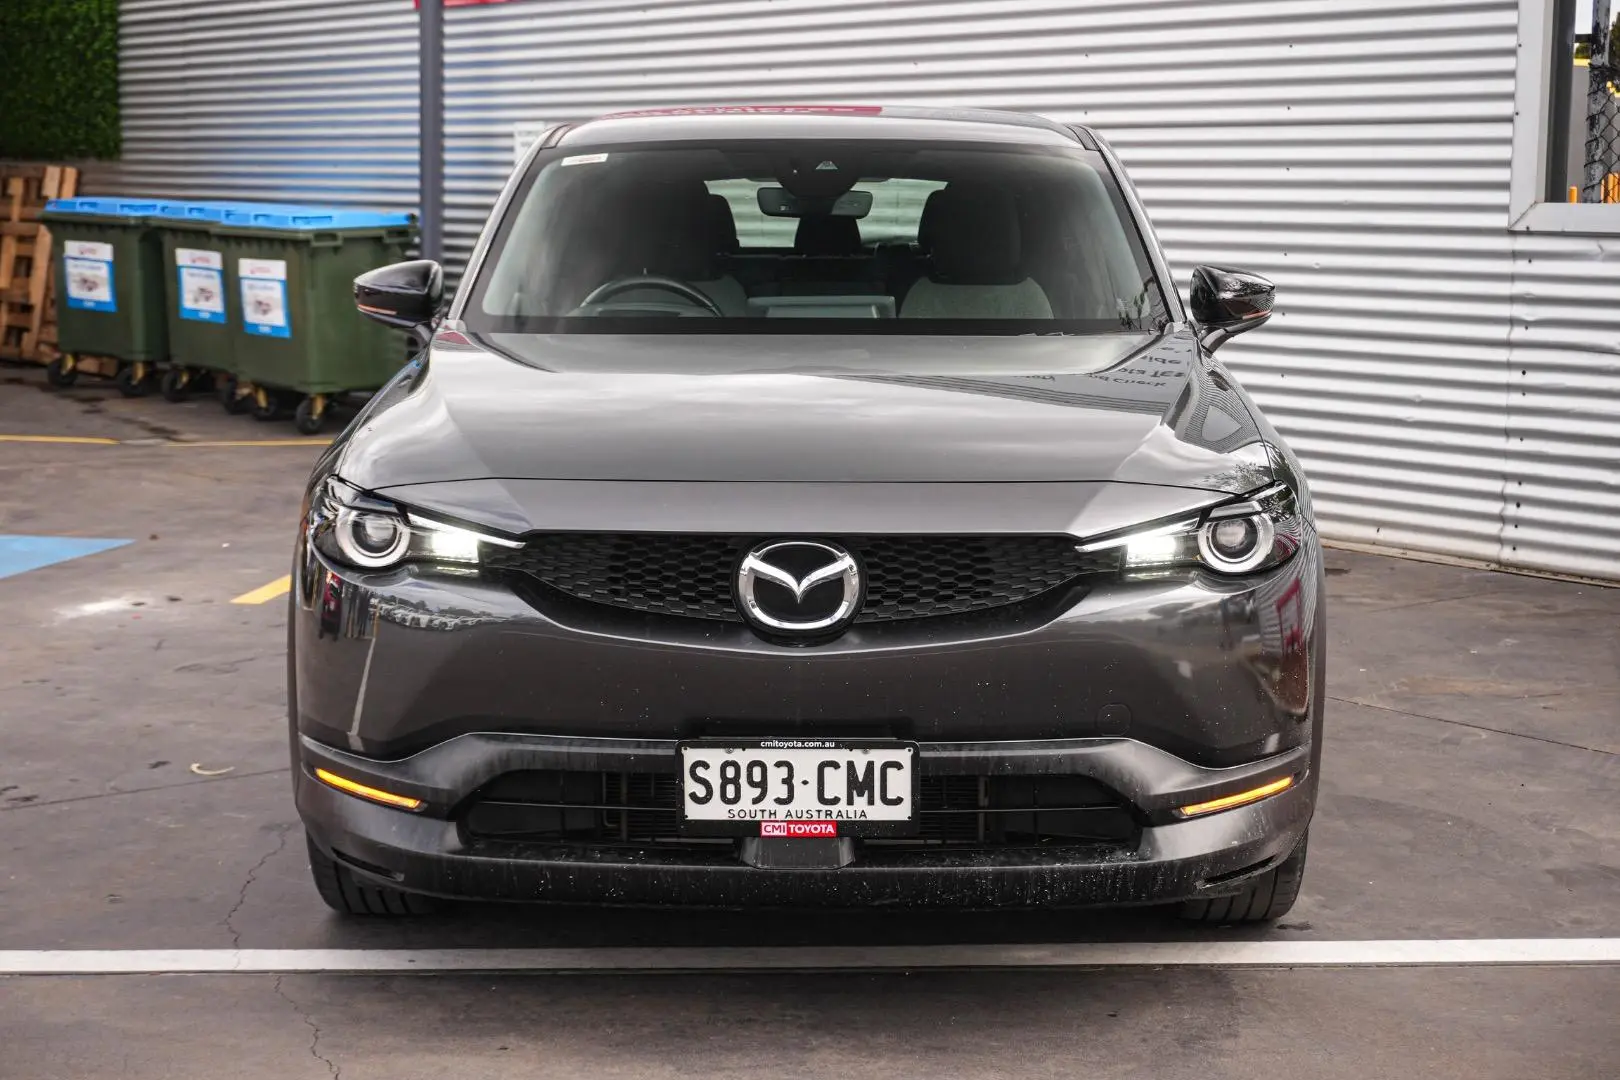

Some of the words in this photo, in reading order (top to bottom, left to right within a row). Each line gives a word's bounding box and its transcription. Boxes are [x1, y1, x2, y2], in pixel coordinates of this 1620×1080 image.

[761, 740, 835, 748] cmitoyota.com.au
[728, 809, 777, 819] SOUTH
[785, 809, 867, 819] AUSTRALIA
[763, 824, 786, 833] CMI
[788, 824, 834, 833] TOYOTA
